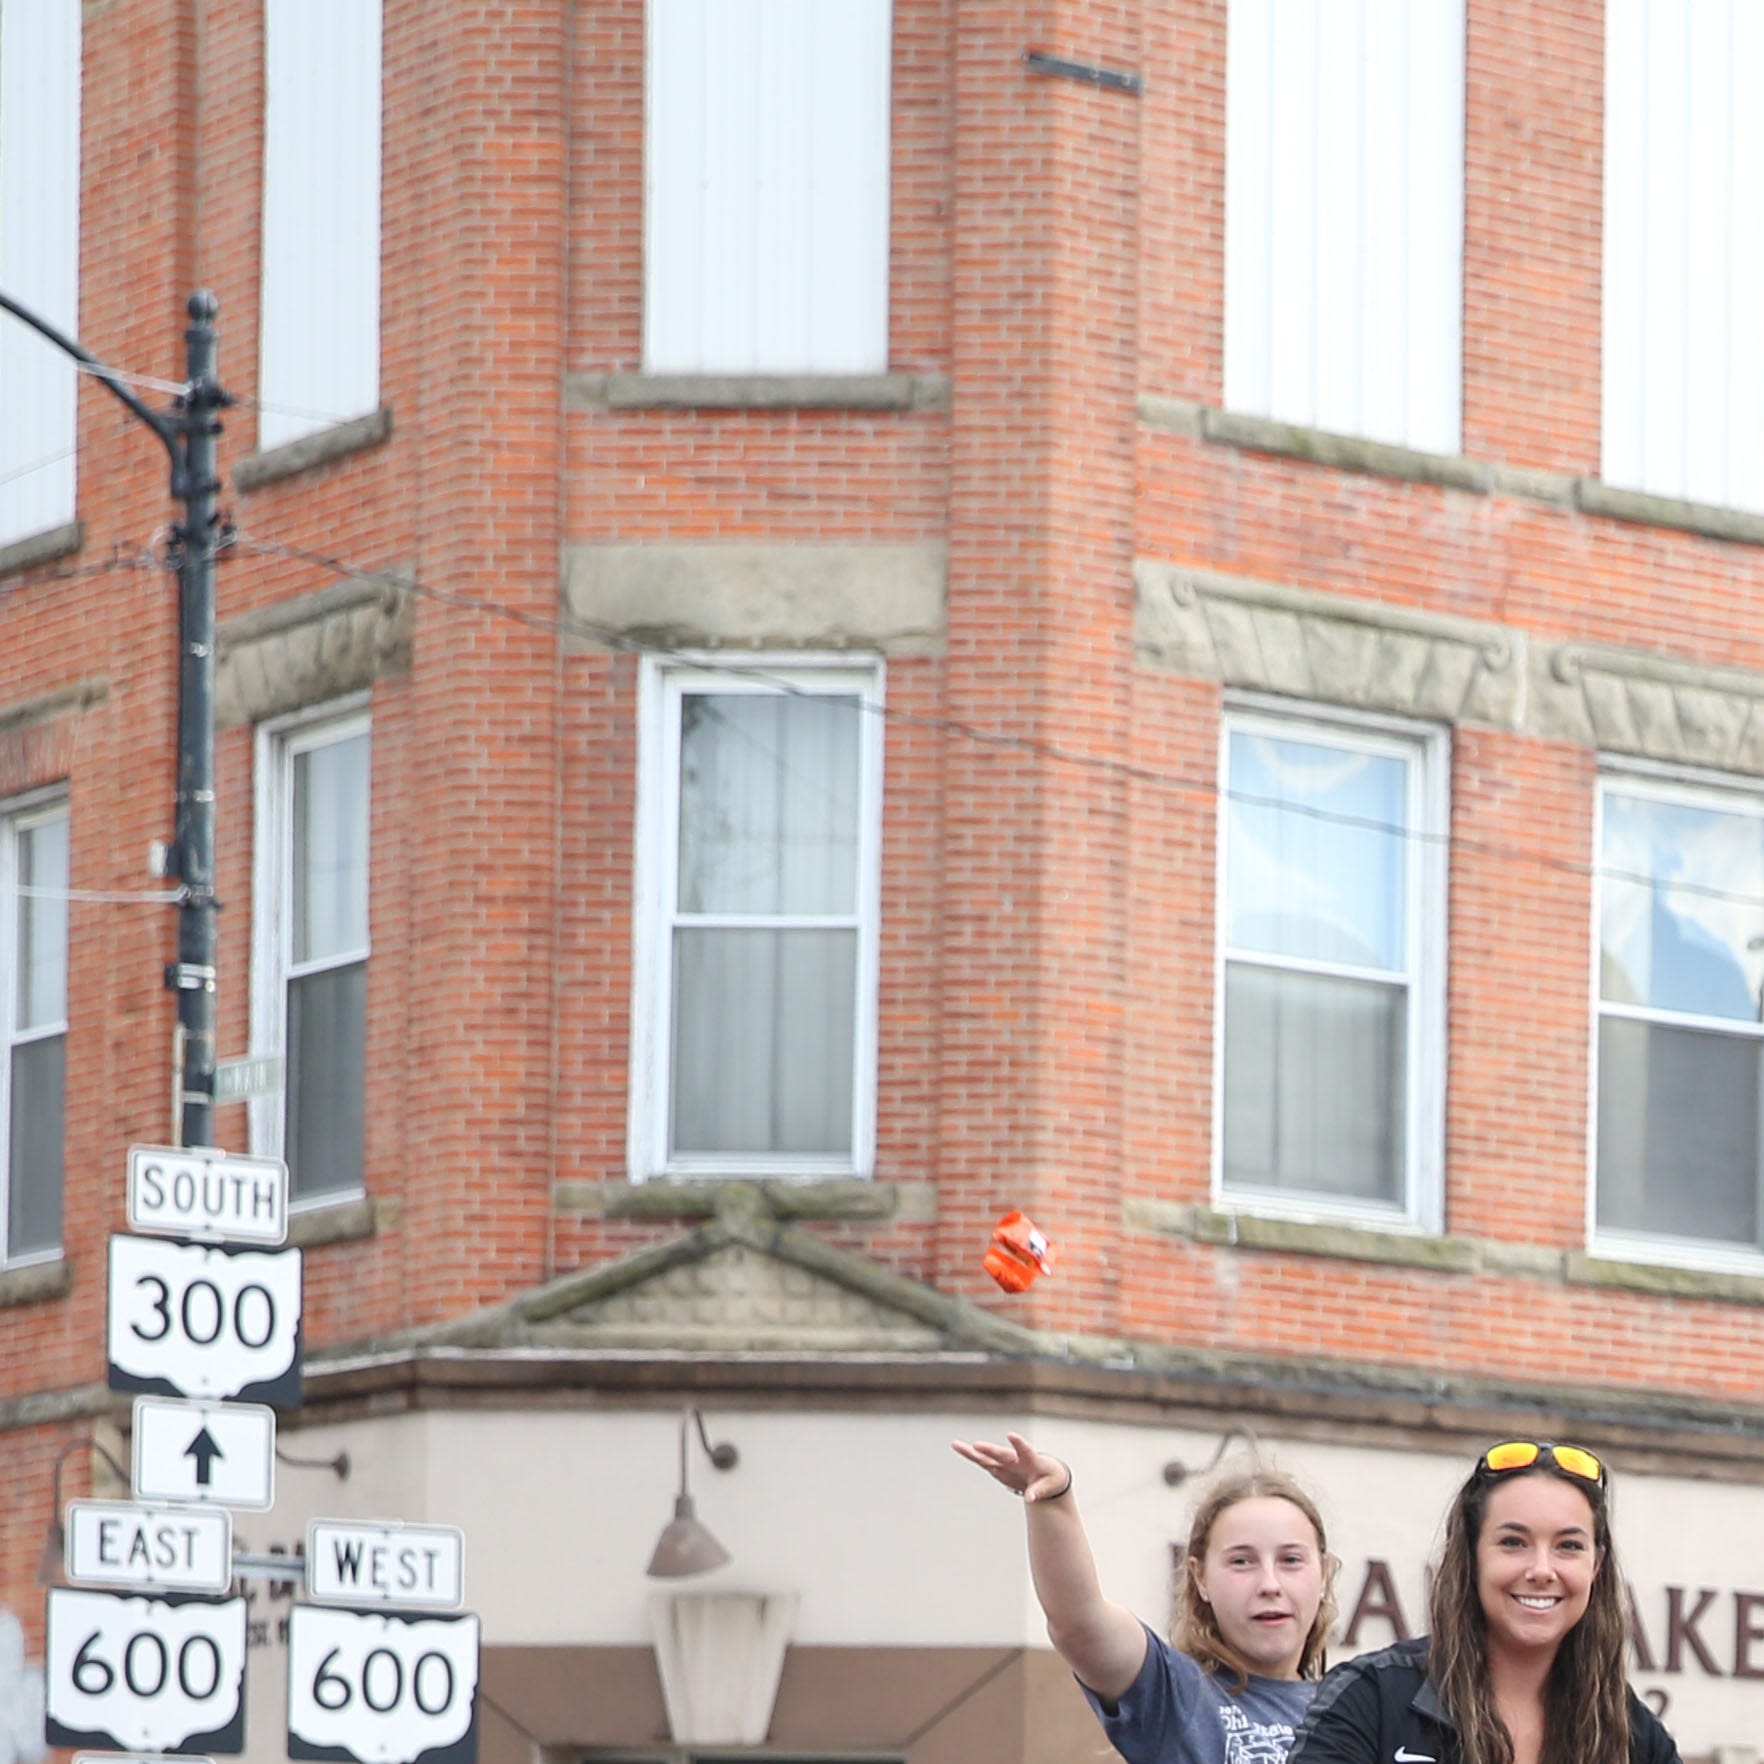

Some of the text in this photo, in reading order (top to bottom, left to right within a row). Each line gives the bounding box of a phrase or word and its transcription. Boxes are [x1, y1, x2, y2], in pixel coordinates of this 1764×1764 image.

[142, 1165, 276, 1224] SOUTH
[130, 1275, 276, 1348] 300
[98, 1519, 201, 1571] EAST
[333, 1537, 441, 1592] WEST
[71, 1631, 222, 1701] 600
[310, 1646, 455, 1716] 600
